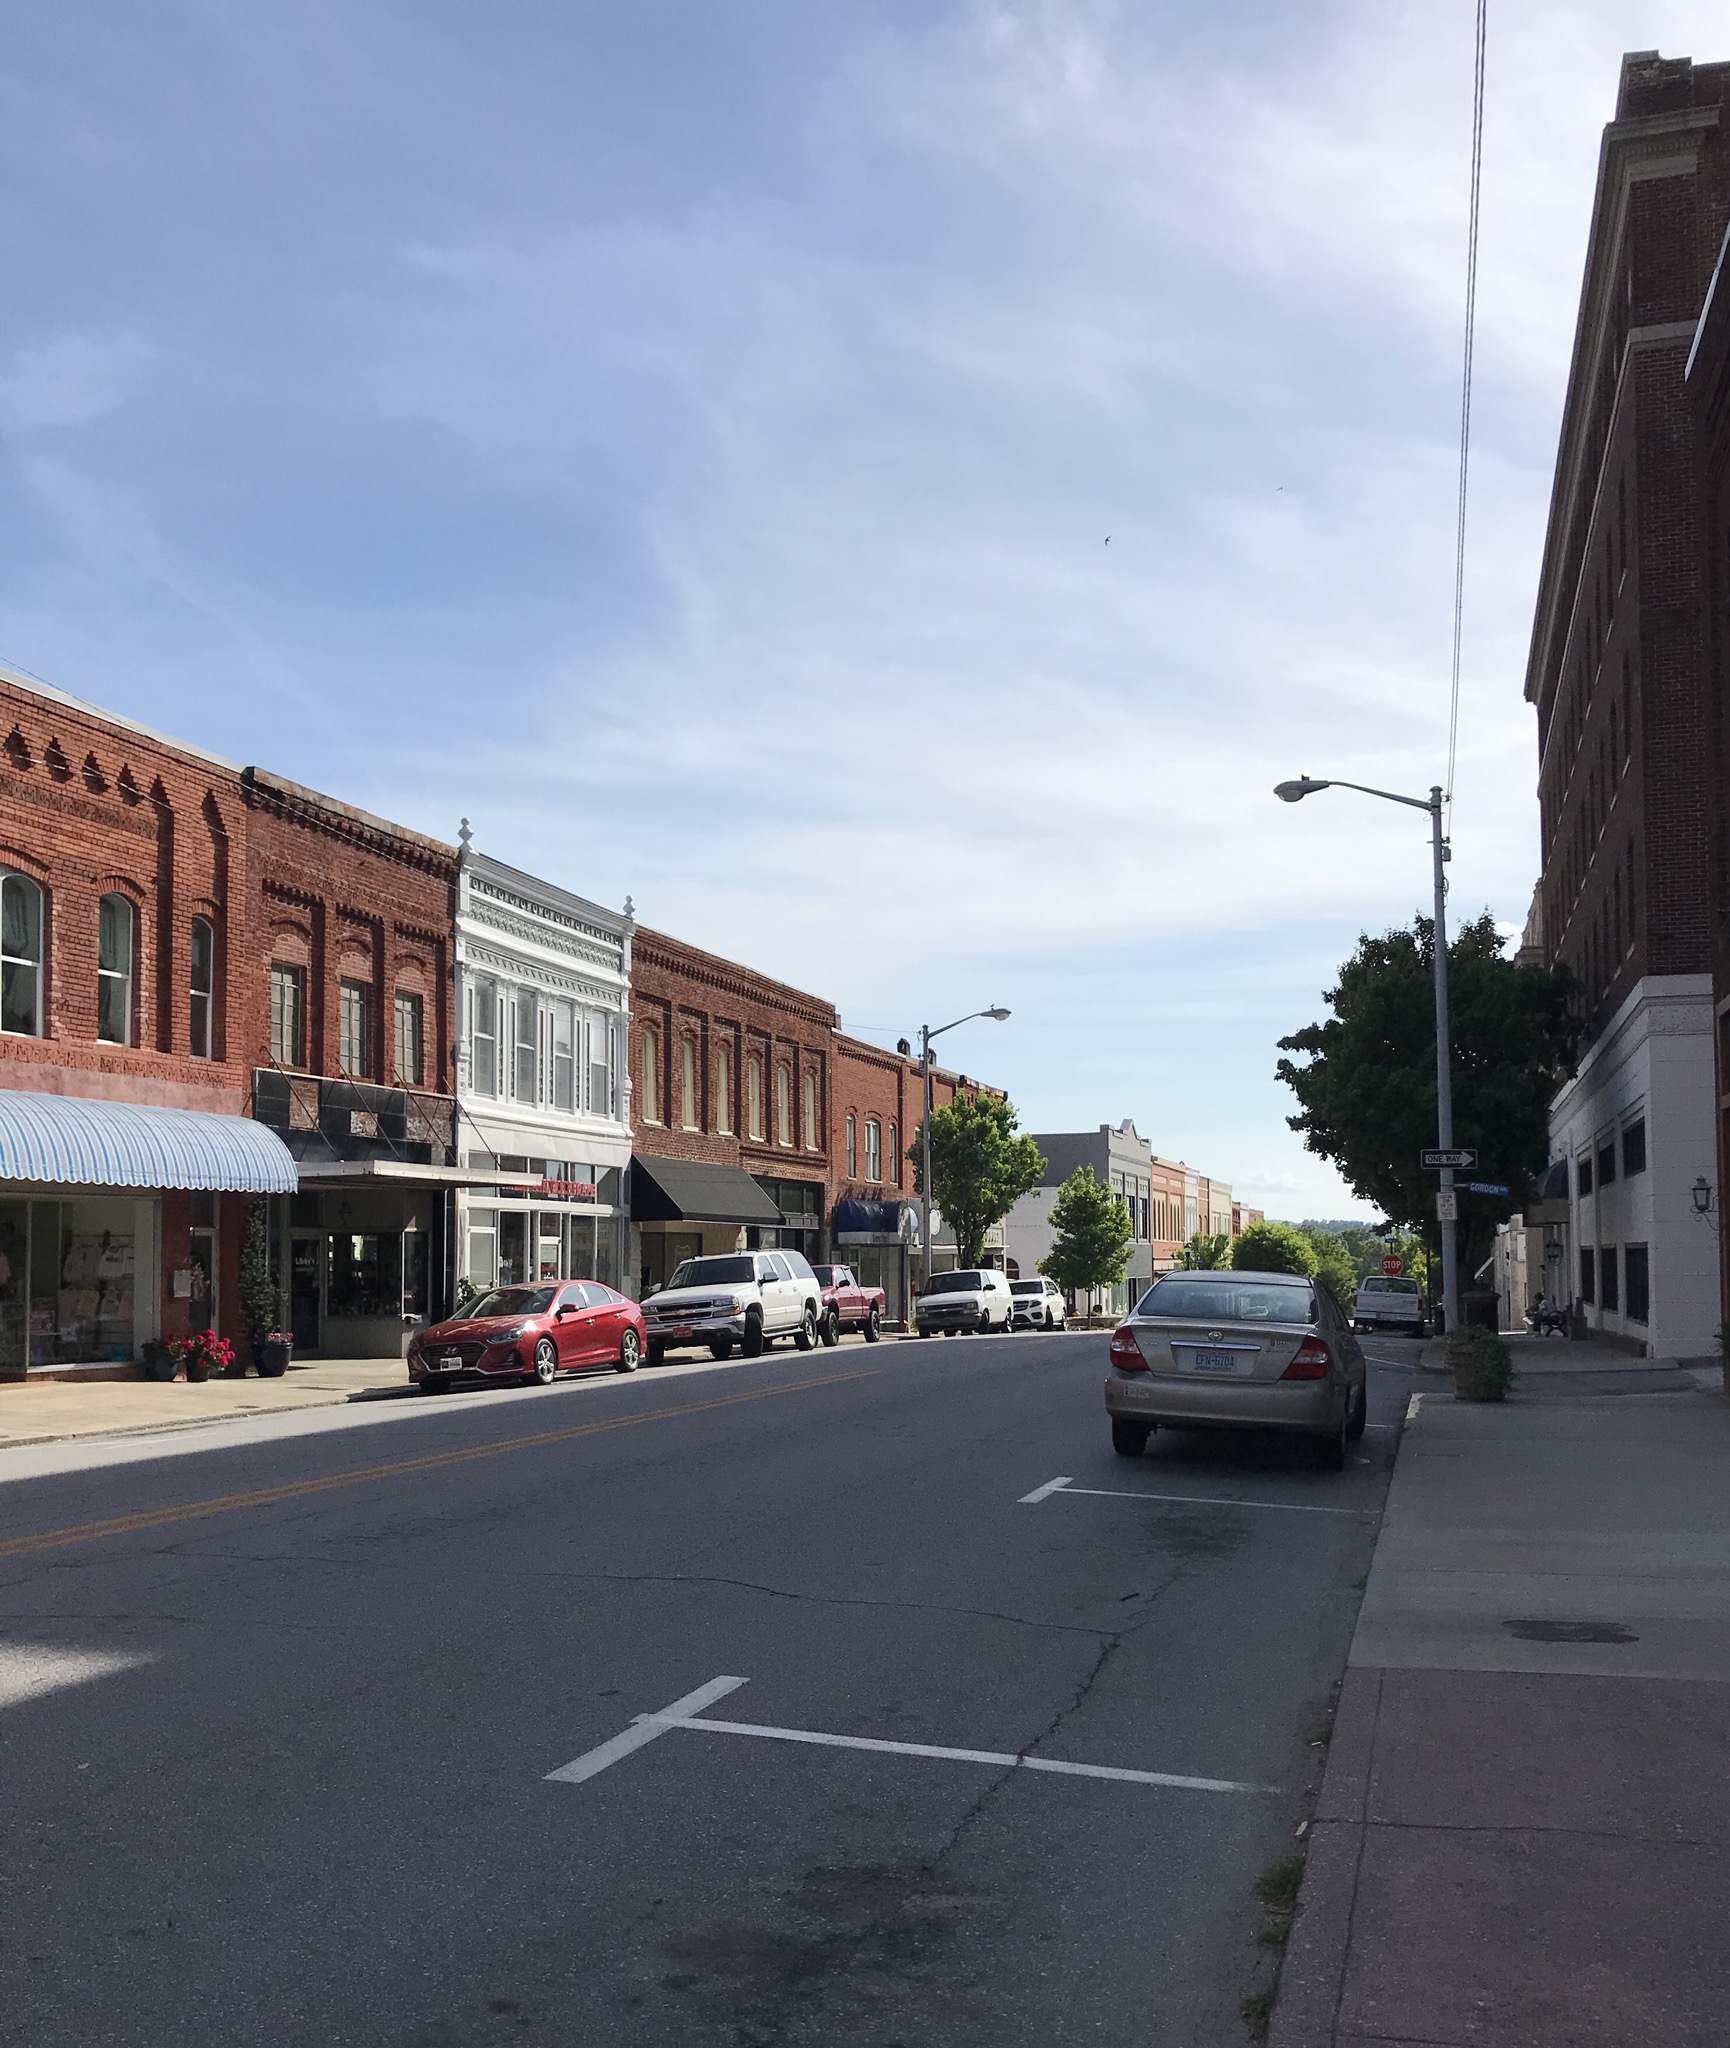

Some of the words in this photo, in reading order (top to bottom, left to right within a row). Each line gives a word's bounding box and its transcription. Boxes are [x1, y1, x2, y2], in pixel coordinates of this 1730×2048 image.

[1427, 1155, 1443, 1163] ONE
[1446, 1155, 1461, 1163] WAY
[1470, 1182, 1499, 1194] GORDON
[1382, 1260, 1402, 1269] STOP
[1195, 1354, 1235, 1367] CFN-6704
